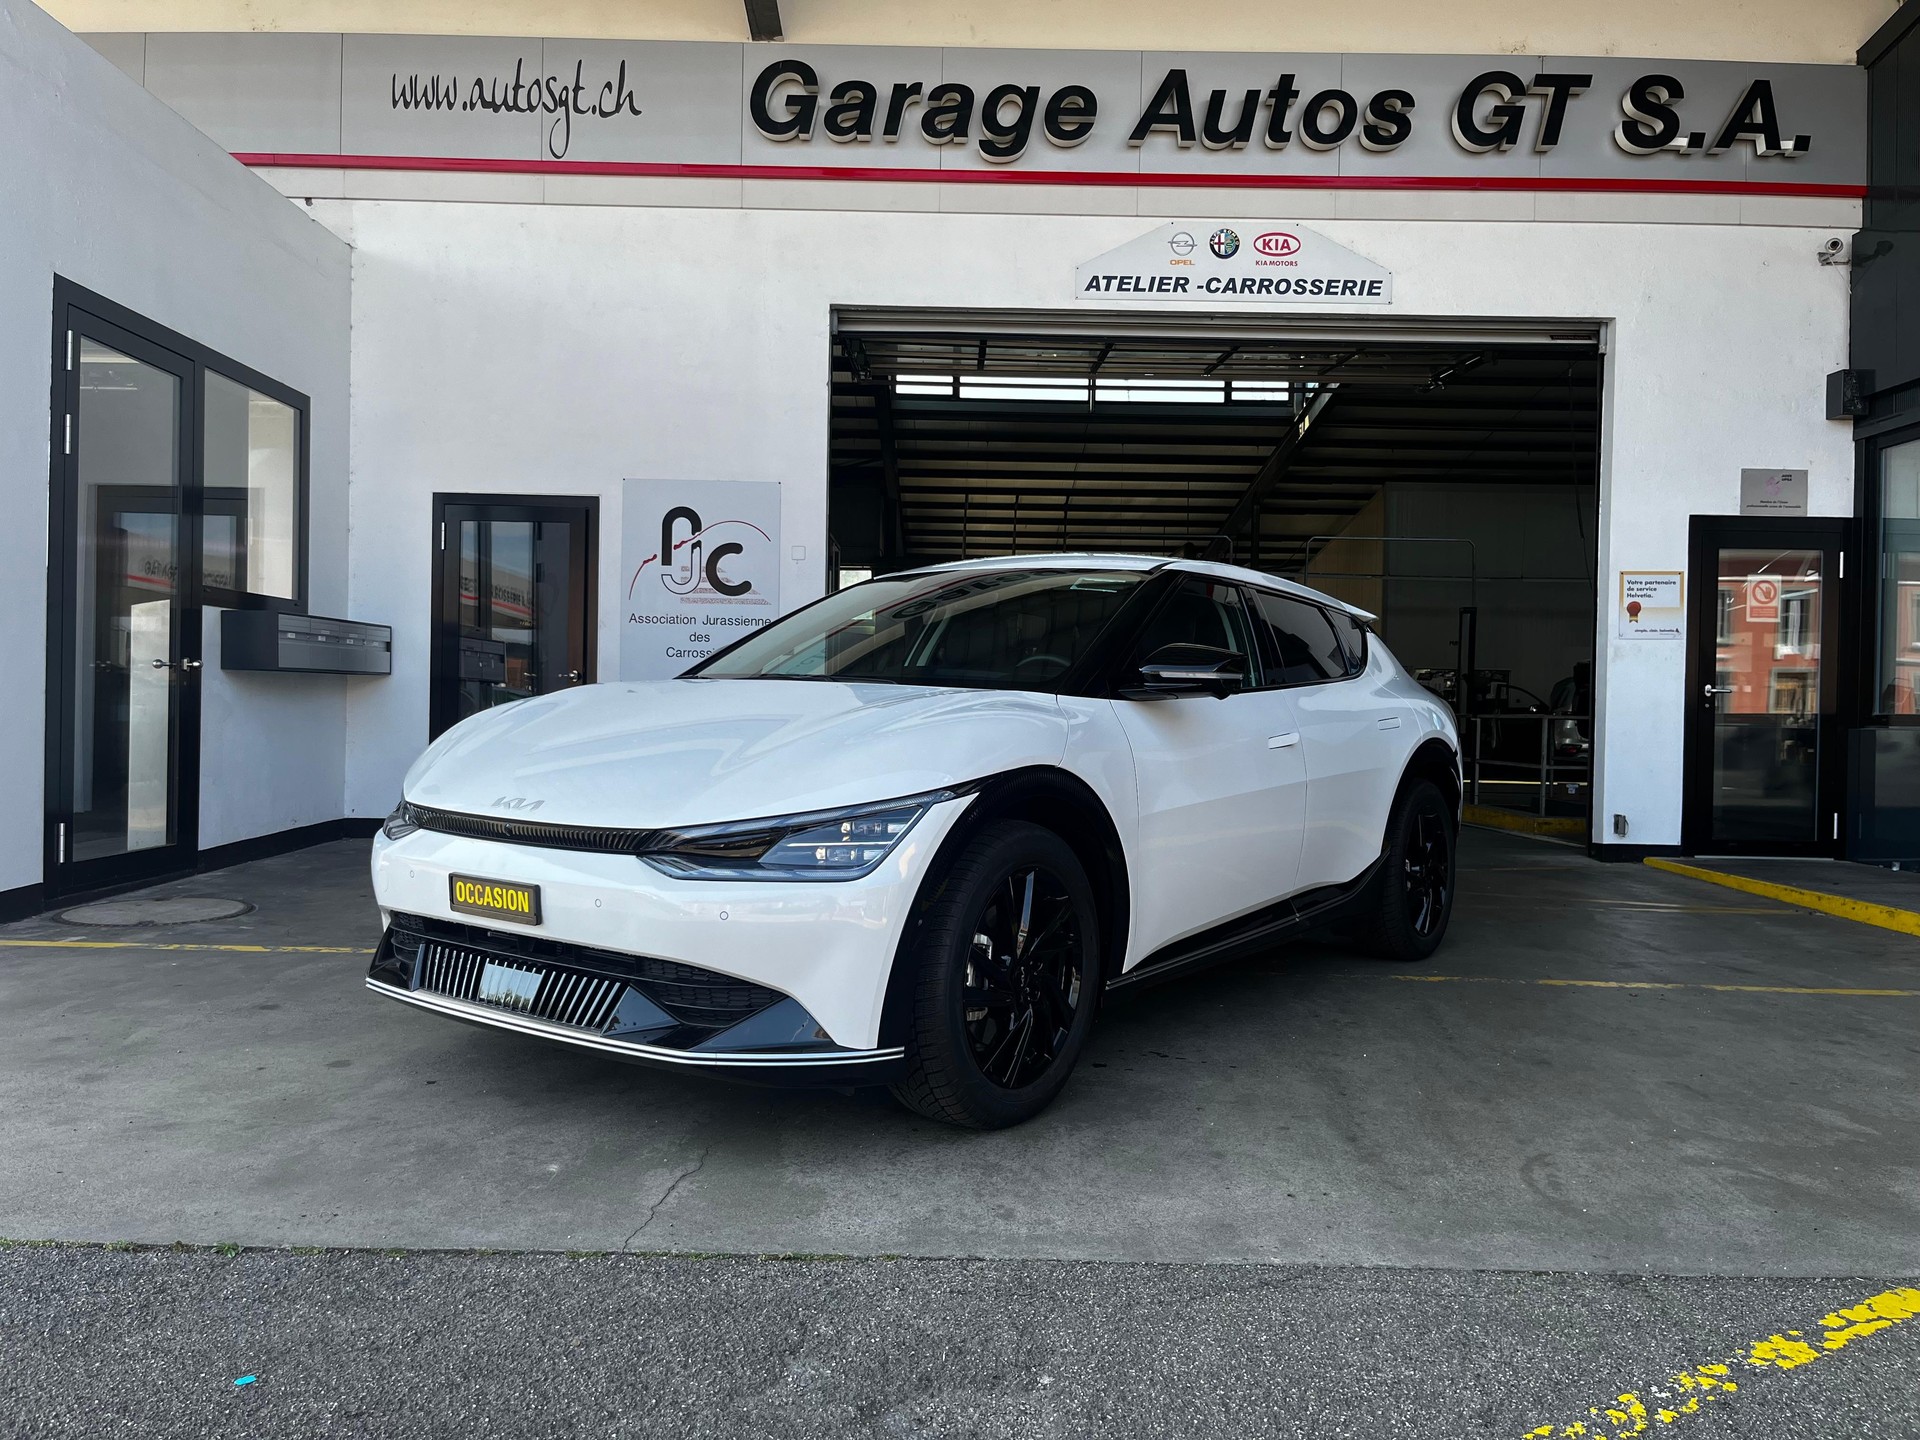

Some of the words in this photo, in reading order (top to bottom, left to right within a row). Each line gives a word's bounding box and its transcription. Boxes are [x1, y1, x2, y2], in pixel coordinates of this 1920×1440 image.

[391, 57, 643, 159] www.autosgt.ch
[749, 59, 1099, 164] Garage
[1127, 68, 1416, 151] Autos
[1452, 70, 1592, 154] GT
[1615, 74, 1812, 158] S.A.
[1262, 238, 1292, 251] KIA
[1084, 275, 1190, 293] ATELIER
[628, 613, 697, 626] Association
[702, 614, 772, 627] Jurassienne
[689, 632, 711, 643] des
[456, 881, 530, 913] OCCASION
